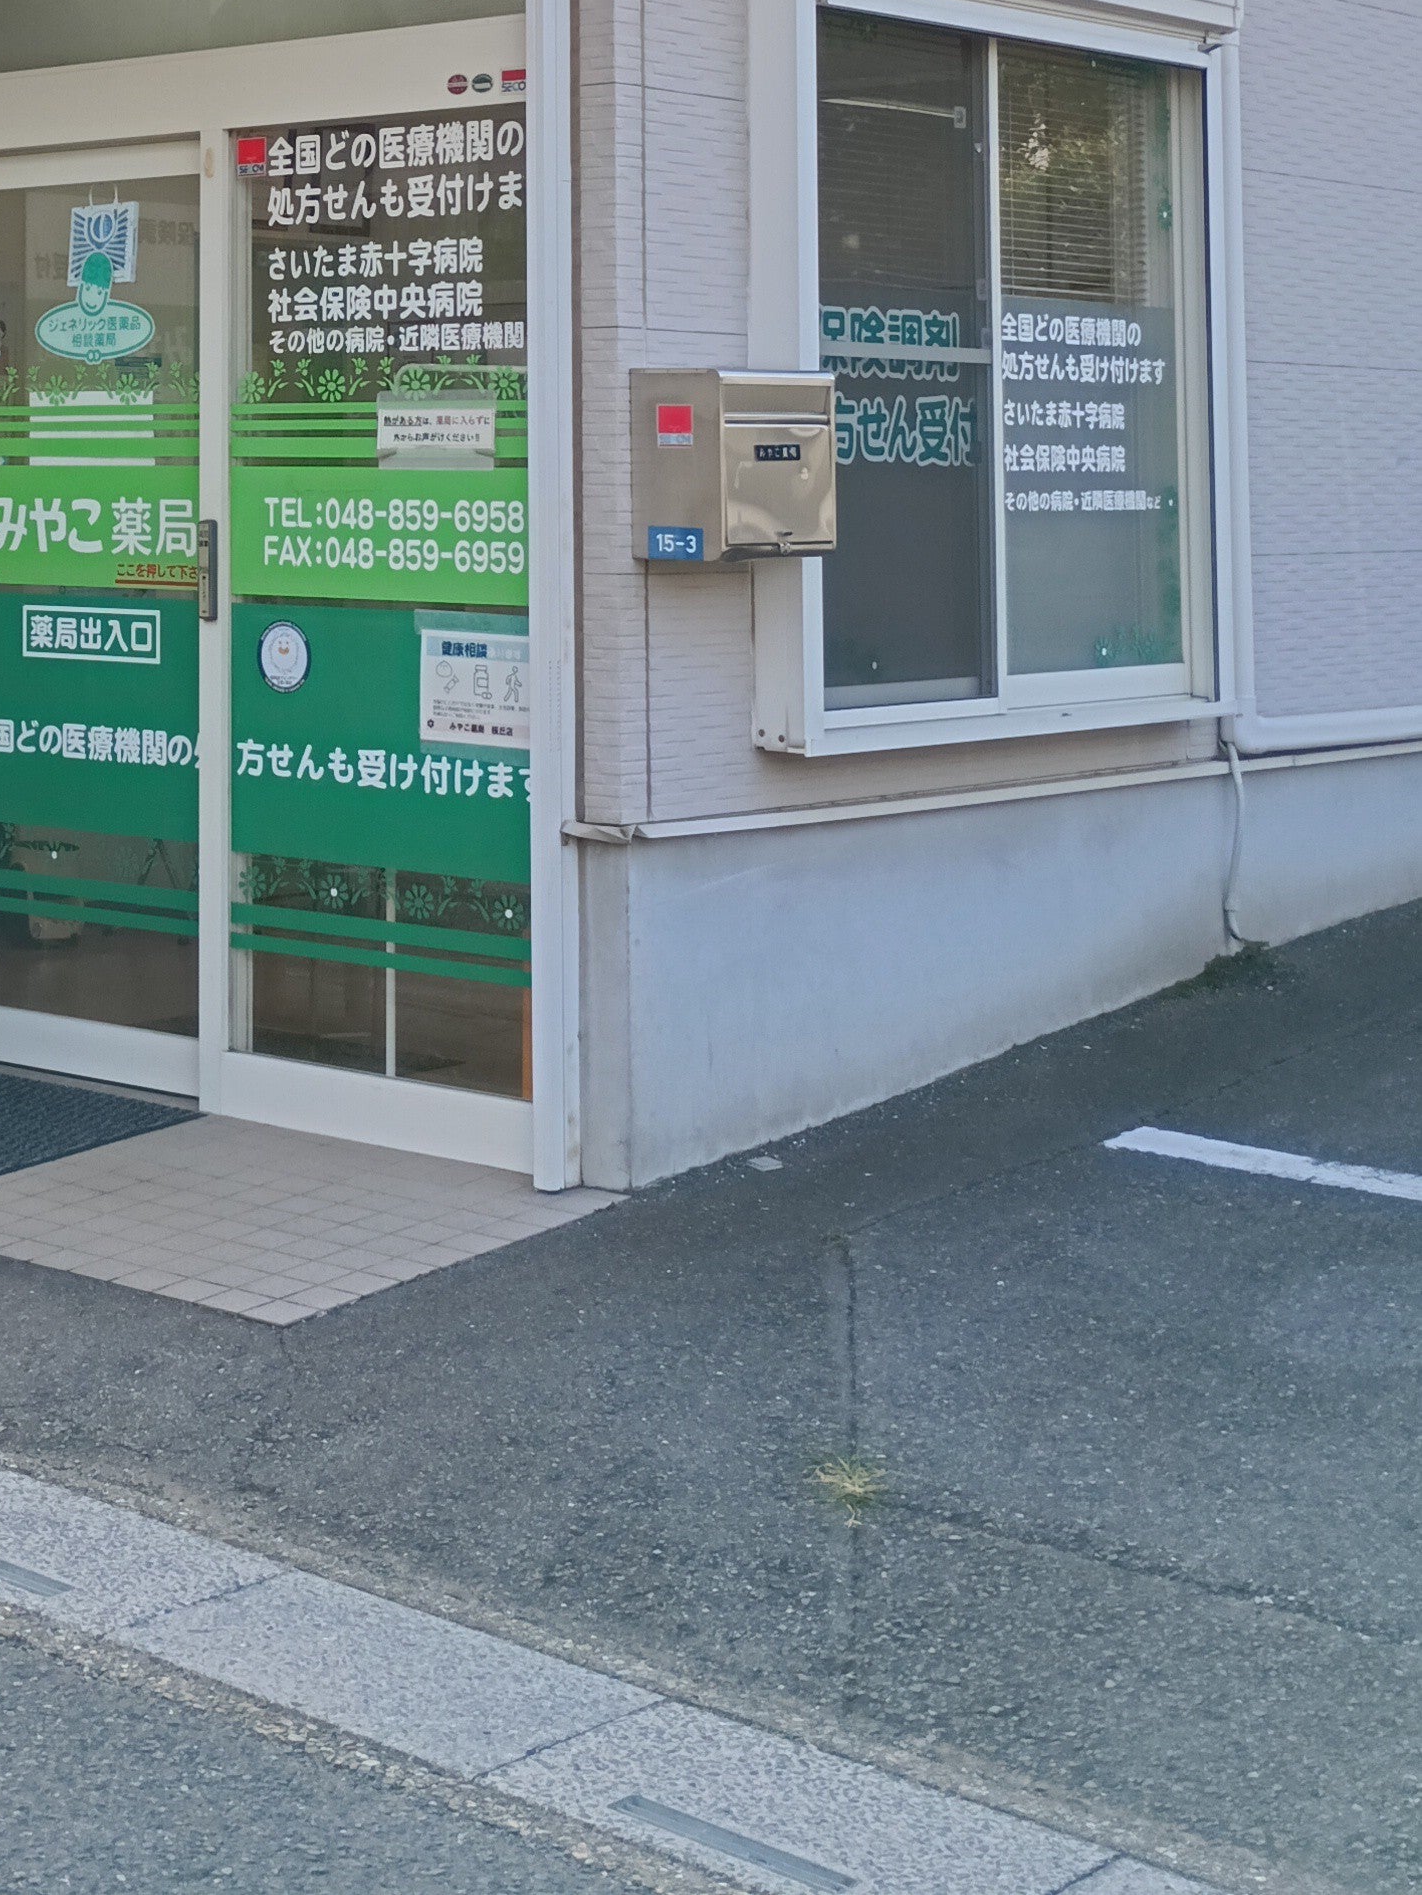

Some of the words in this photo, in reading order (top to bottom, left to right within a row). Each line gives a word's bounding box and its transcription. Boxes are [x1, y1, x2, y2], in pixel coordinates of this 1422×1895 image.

[268, 118, 524, 177] 全国どの医療機関の
[267, 171, 523, 227] 処方せんも受付けま
[268, 236, 483, 281] さいたま赤十字病院
[267, 280, 483, 323] 社会保険中央病院
[268, 321, 525, 354] その他の病院・近隣医療機関
[1001, 312, 1142, 349] 全国どの医療機関の
[1001, 351, 1166, 386] 処方せんも受け付けます
[1003, 399, 1126, 432] さいたま赤十字病院
[1003, 444, 1126, 474] 社会保険中央病院
[656, 533, 697, 554] 15-3
[29, 614, 154, 653] 薬局出入口
